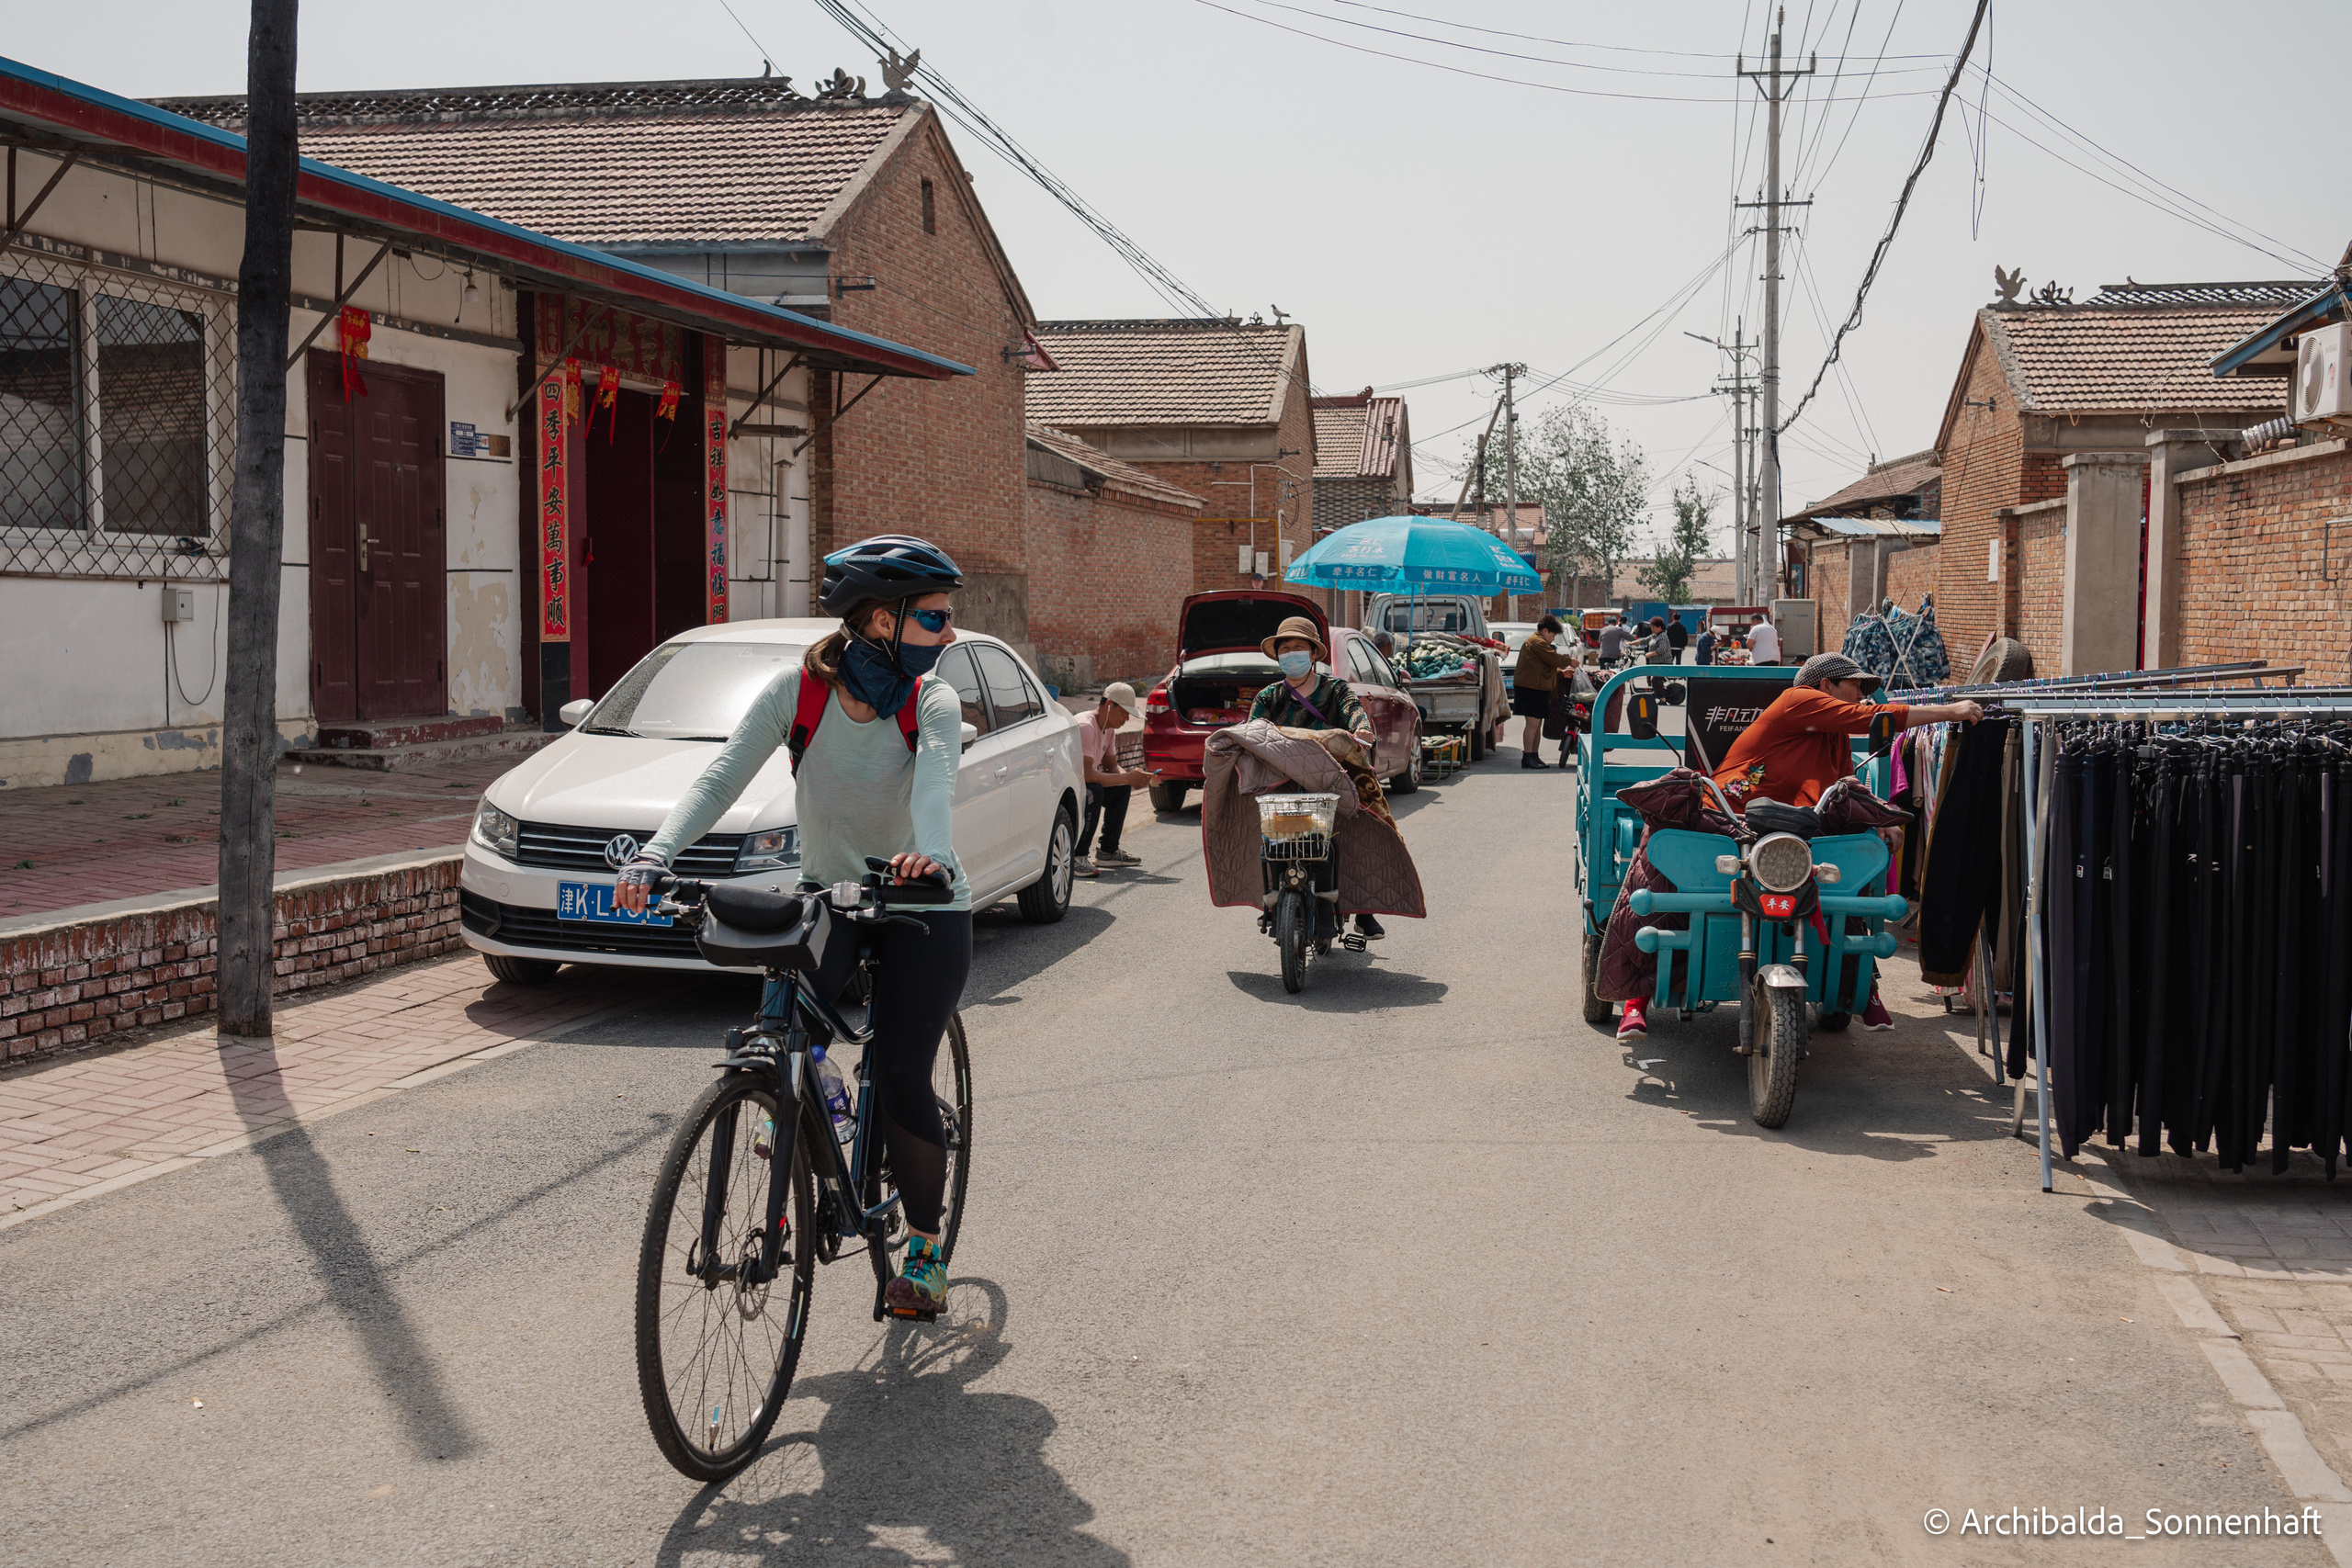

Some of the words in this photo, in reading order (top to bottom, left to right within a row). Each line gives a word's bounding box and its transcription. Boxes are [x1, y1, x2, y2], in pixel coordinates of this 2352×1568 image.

[1332, 567, 1377, 577] 牵手名仁
[1423, 569, 1482, 584] 做财富名人
[1506, 576, 1531, 586] 牵手名仁
[1767, 897, 1790, 910] 平安
